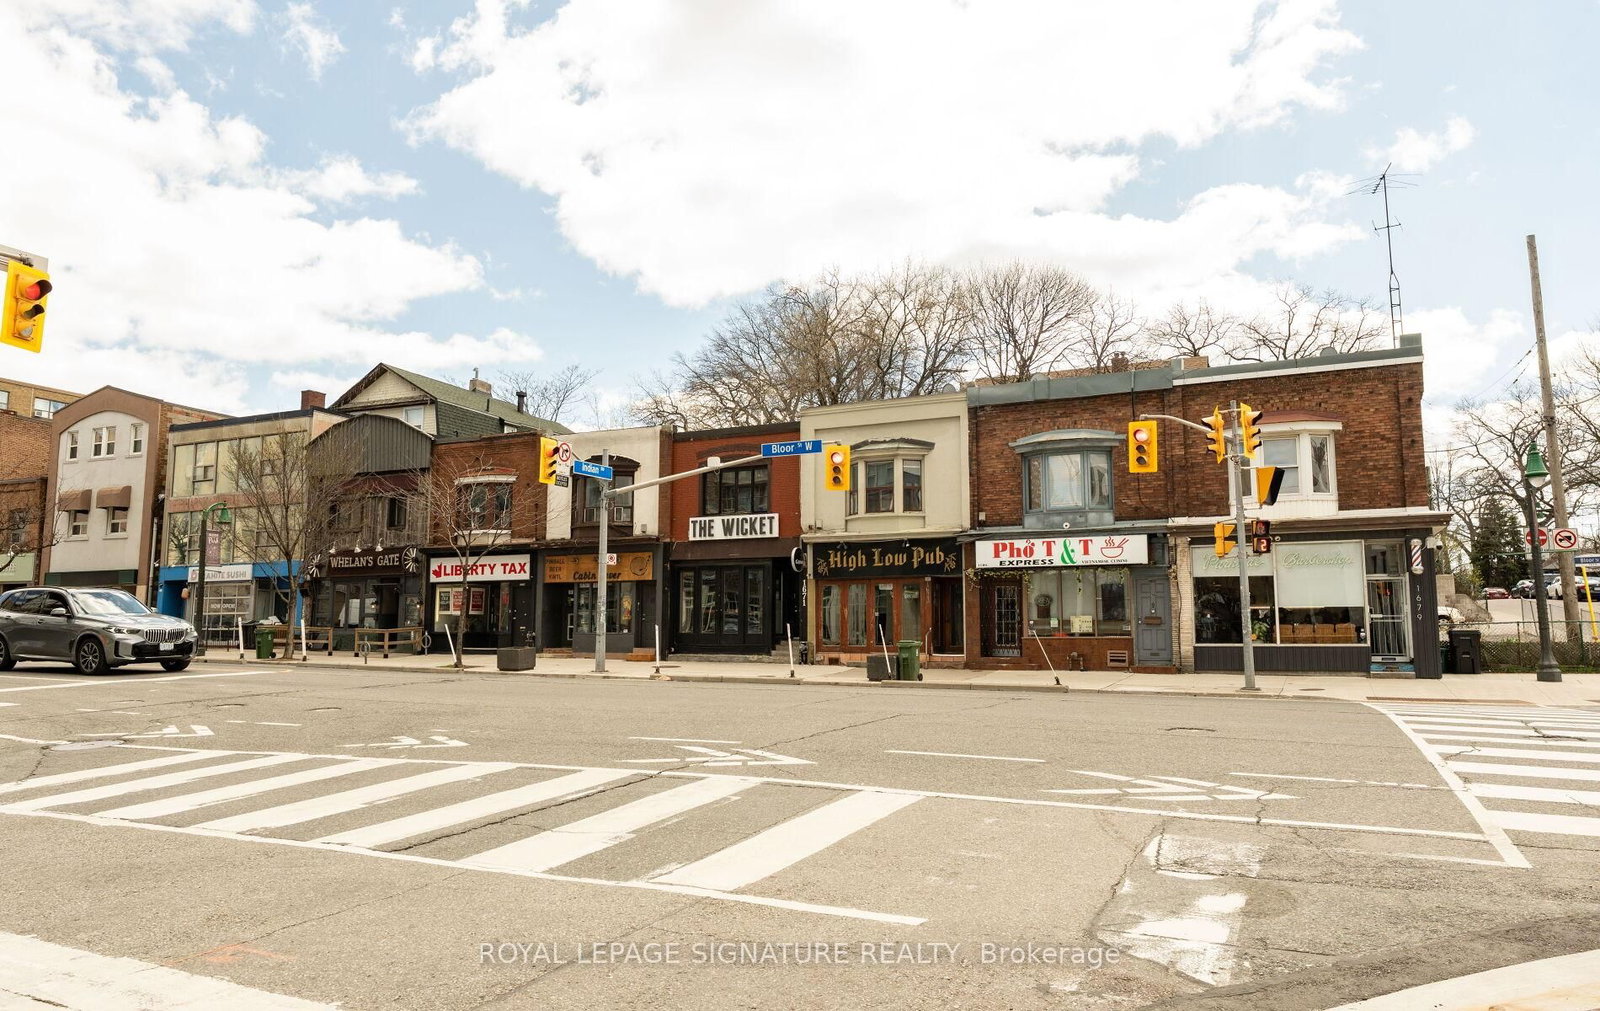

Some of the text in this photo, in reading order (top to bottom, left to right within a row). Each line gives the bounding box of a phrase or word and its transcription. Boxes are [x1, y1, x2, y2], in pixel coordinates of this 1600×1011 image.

[771, 445, 794, 453] Bloor
[805, 442, 812, 451] W
[691, 516, 775, 538] THE WICKET
[1042, 541, 1056, 557] T
[1061, 538, 1077, 564] &
[1079, 539, 1093, 556] T
[330, 554, 400, 568] WHELAN'S GATE
[828, 546, 945, 571] High Low Pub
[501, 562, 528, 575] TAX
[573, 571, 597, 581] Cabin
